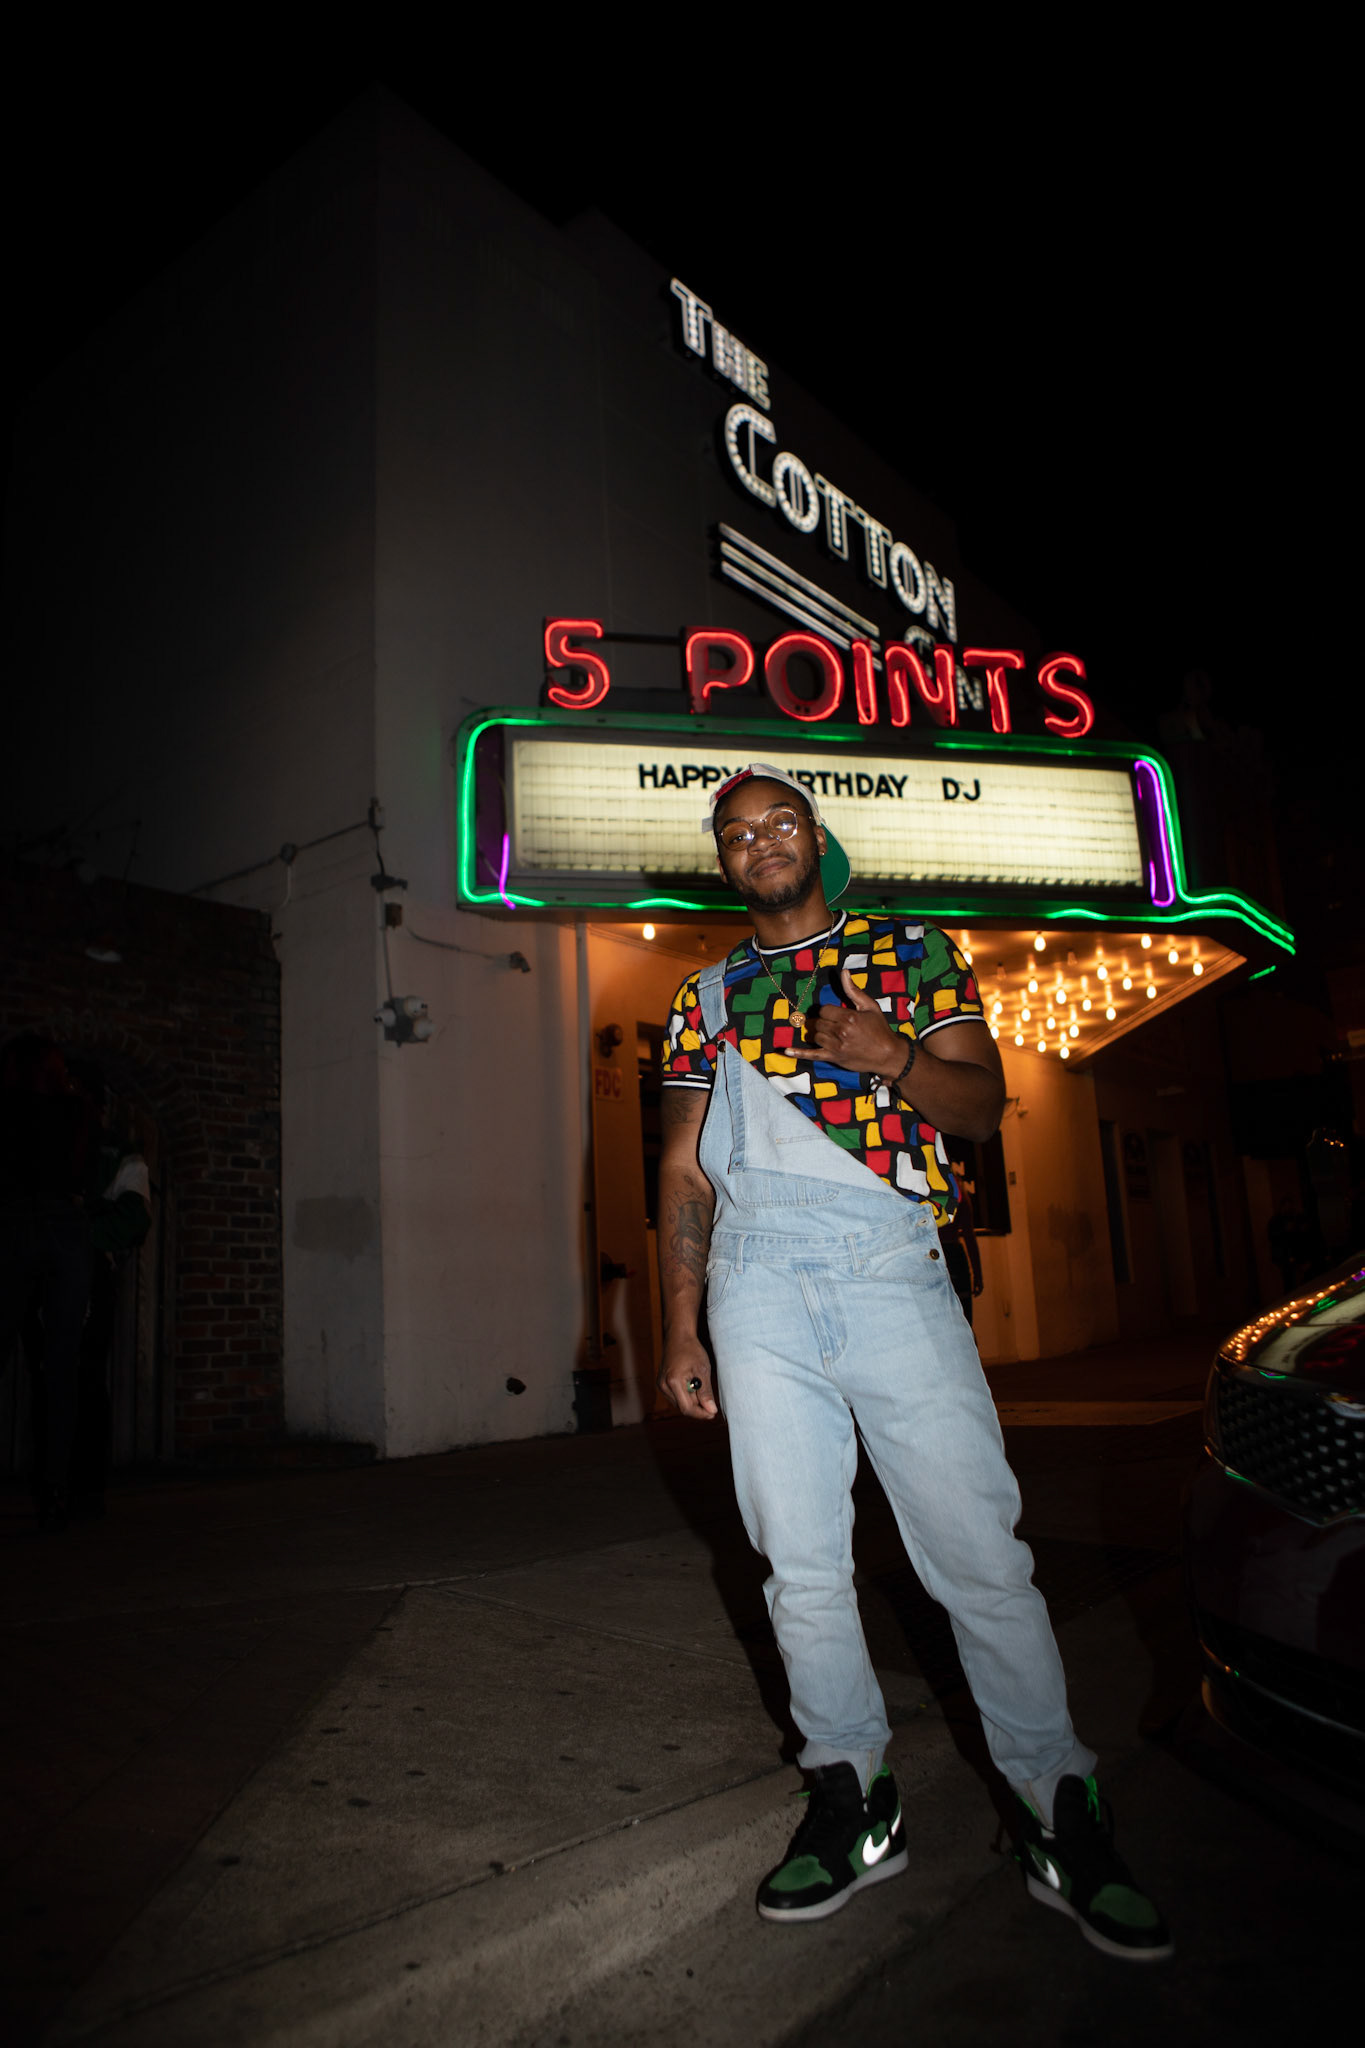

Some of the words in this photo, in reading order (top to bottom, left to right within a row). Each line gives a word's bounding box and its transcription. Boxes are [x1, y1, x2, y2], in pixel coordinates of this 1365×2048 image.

[670, 277, 771, 411] THE
[725, 403, 958, 643] COTTON
[545, 617, 610, 710] 5
[683, 625, 1094, 739] POINTS
[787, 768, 908, 800] RTHDAY
[942, 777, 981, 801] DJ
